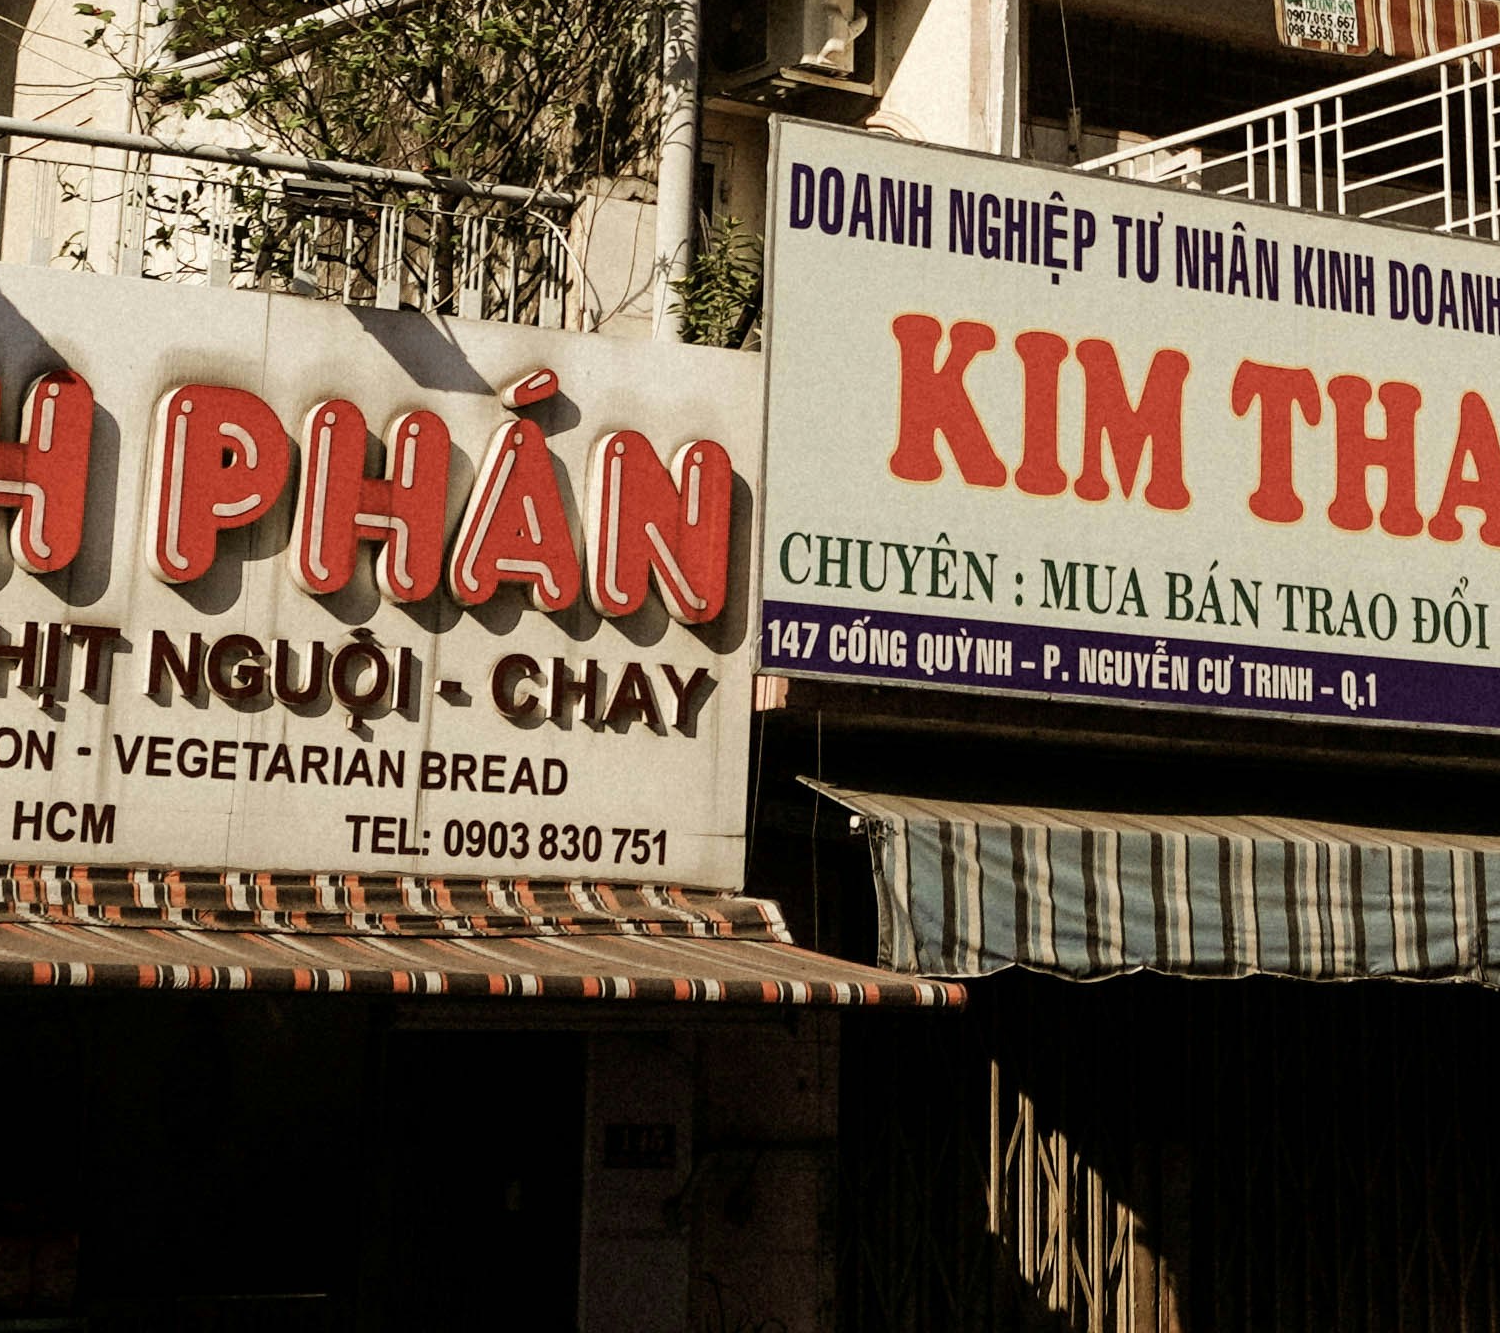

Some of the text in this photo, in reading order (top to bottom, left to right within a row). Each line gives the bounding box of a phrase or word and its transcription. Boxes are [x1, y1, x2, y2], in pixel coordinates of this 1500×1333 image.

[789, 162, 932, 249] DOANH
[949, 190, 1096, 286] NGHIỆP
[1112, 209, 1164, 284] TƯ
[1175, 221, 1280, 303] NHÂN
[1294, 245, 1376, 317] KINH
[887, 312, 1192, 513] KIM
[146, 369, 733, 625] PHÁN
[778, 532, 1000, 605] CHUYÊN
[1039, 557, 1148, 620] MUA
[1165, 558, 1261, 632] BÁN
[1276, 581, 1398, 642] TRAO
[1412, 576, 1491, 651] ĐỔI
[145, 627, 414, 733] NGUỘI
[489, 653, 710, 733] CHAY
[767, 619, 817, 662] 147
[828, 615, 908, 666] CỐNG
[916, 629, 1013, 677] QUỲNH
[1043, 652, 1071, 683] P.
[1078, 638, 1190, 692] NGUYỄN
[1196, 653, 1234, 695] CƯ
[1240, 661, 1314, 703] TRINH
[1341, 670, 1379, 712] Q.1
[113, 734, 406, 790] VEGETARIAN
[421, 752, 569, 796] BREAD
[13, 800, 116, 845] HCM
[345, 813, 430, 857] TEL:
[443, 819, 529, 862] 0903
[537, 824, 604, 865] 830
[611, 828, 668, 867] 751
